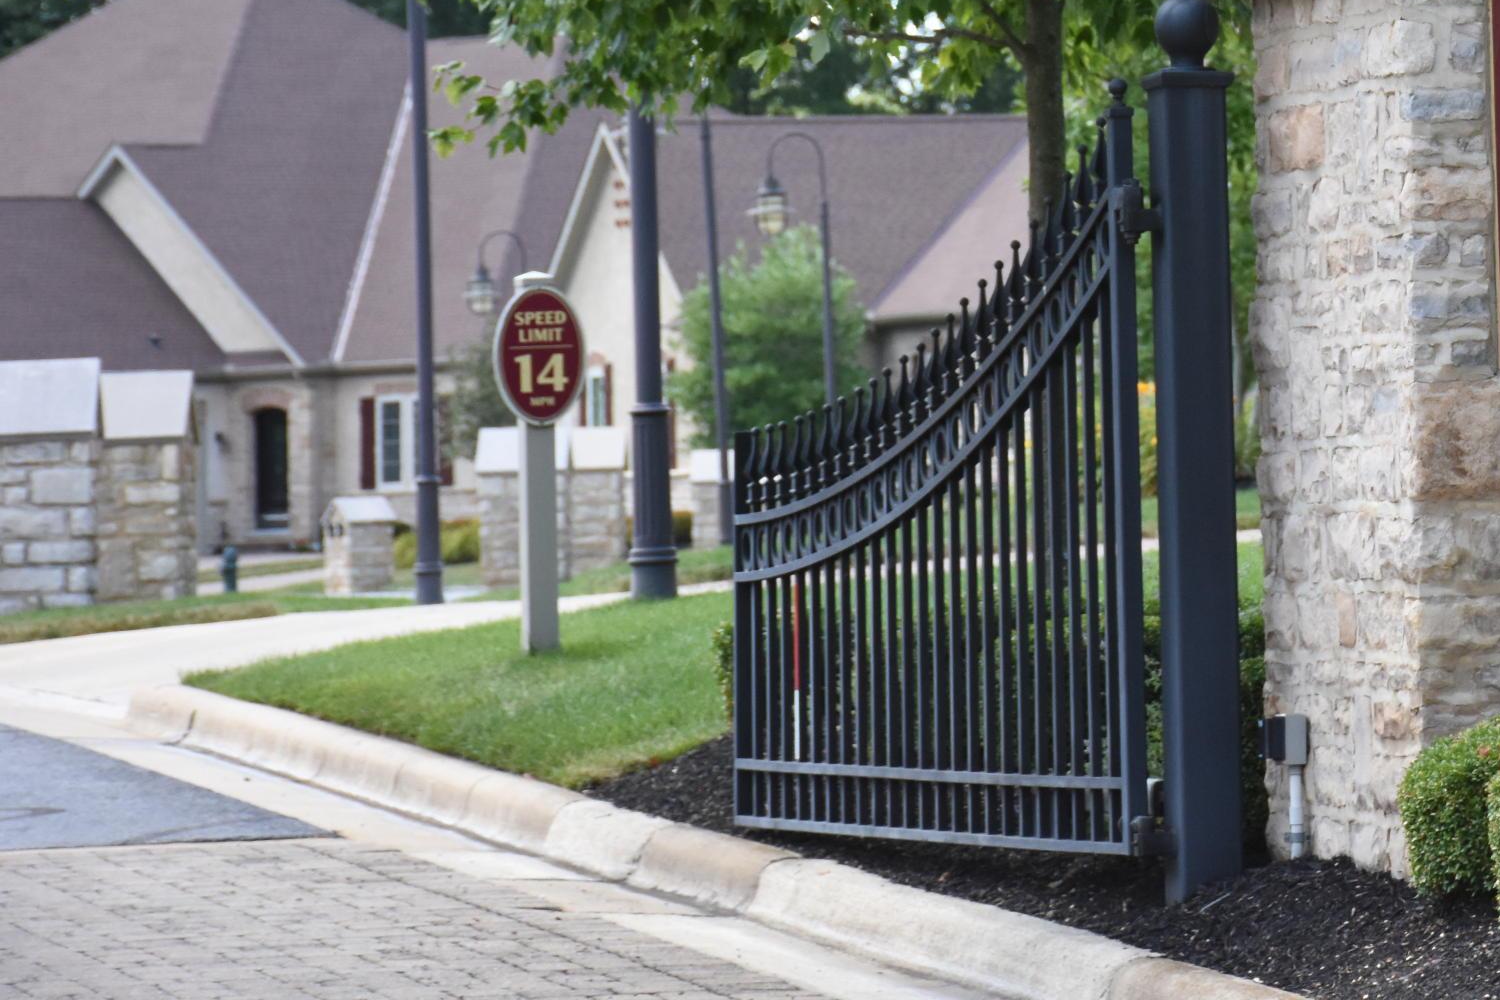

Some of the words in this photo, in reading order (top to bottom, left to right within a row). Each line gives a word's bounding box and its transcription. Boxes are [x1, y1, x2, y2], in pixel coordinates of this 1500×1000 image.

[514, 310, 567, 326] SPEED
[518, 327, 563, 343] LIMIT
[513, 353, 569, 394] 14
